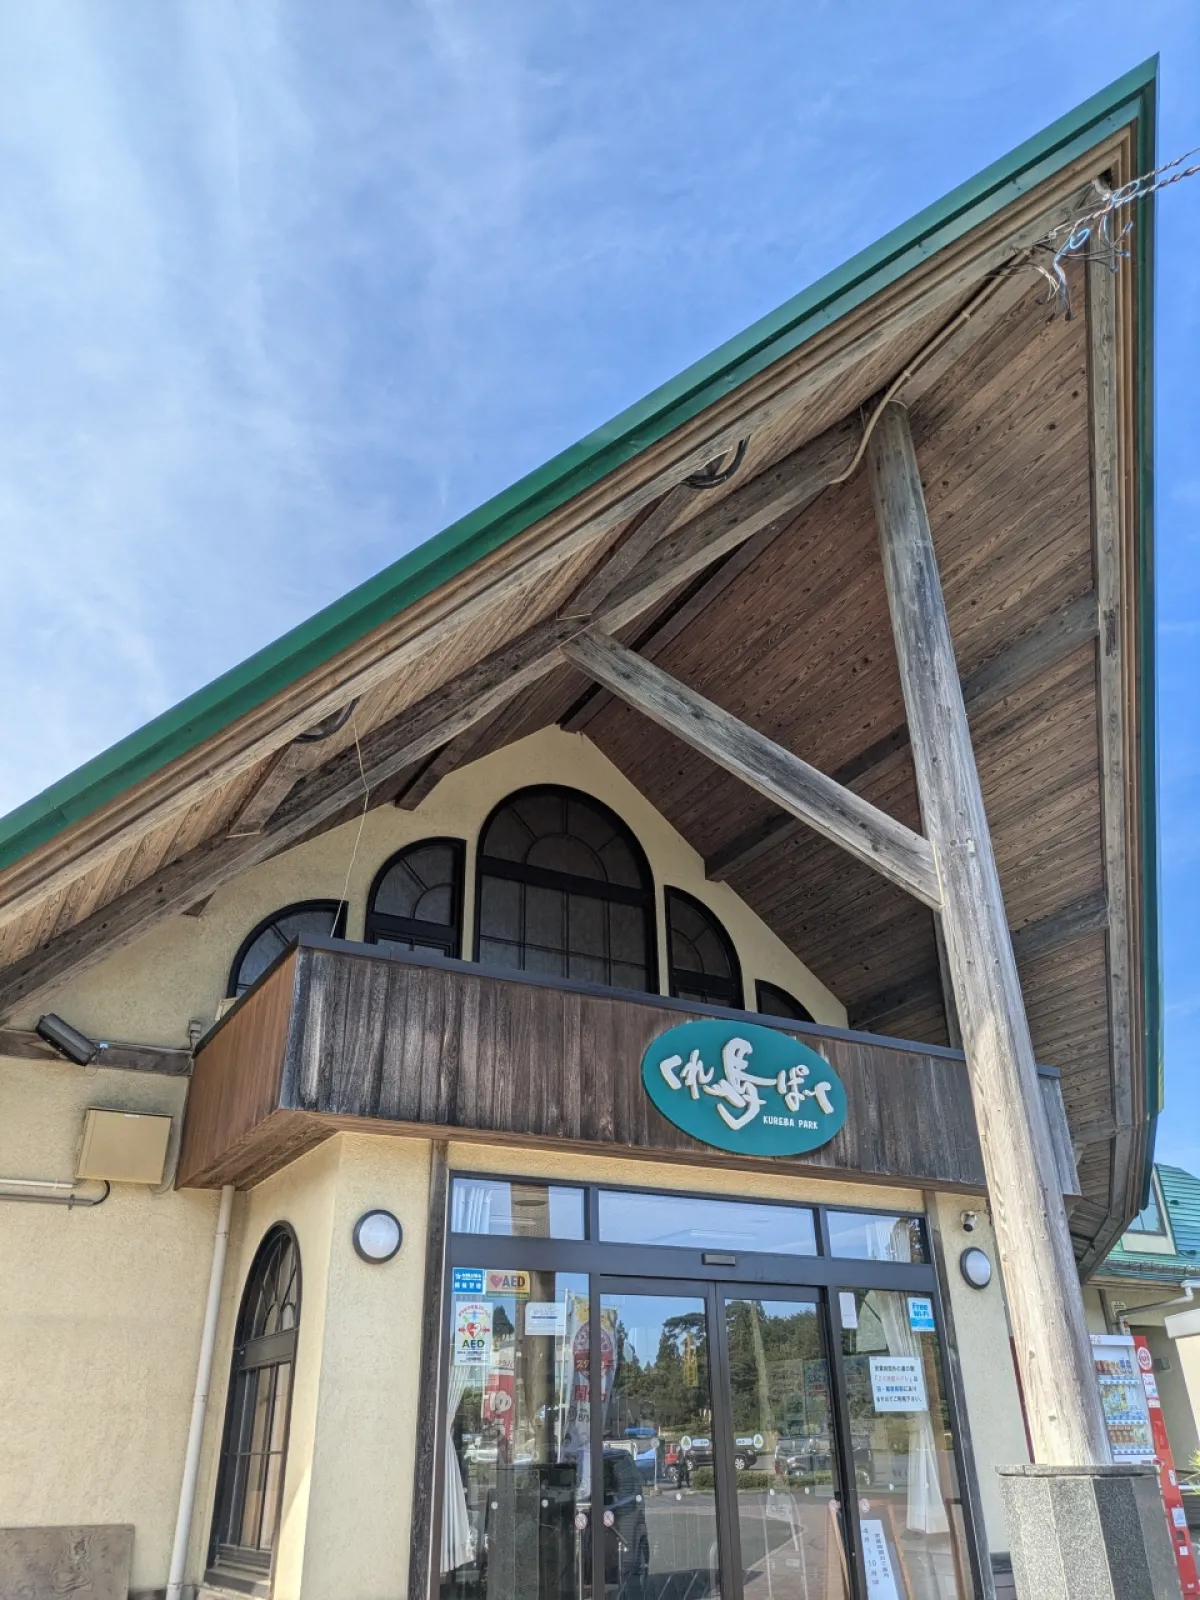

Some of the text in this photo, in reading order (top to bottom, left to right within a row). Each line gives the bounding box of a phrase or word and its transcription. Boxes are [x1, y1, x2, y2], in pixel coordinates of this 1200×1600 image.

[763, 1115, 819, 1130] KUREBA PARK
[502, 1275, 526, 1288] AED
[912, 1302, 928, 1311] Free
[462, 1339, 485, 1349] AED
